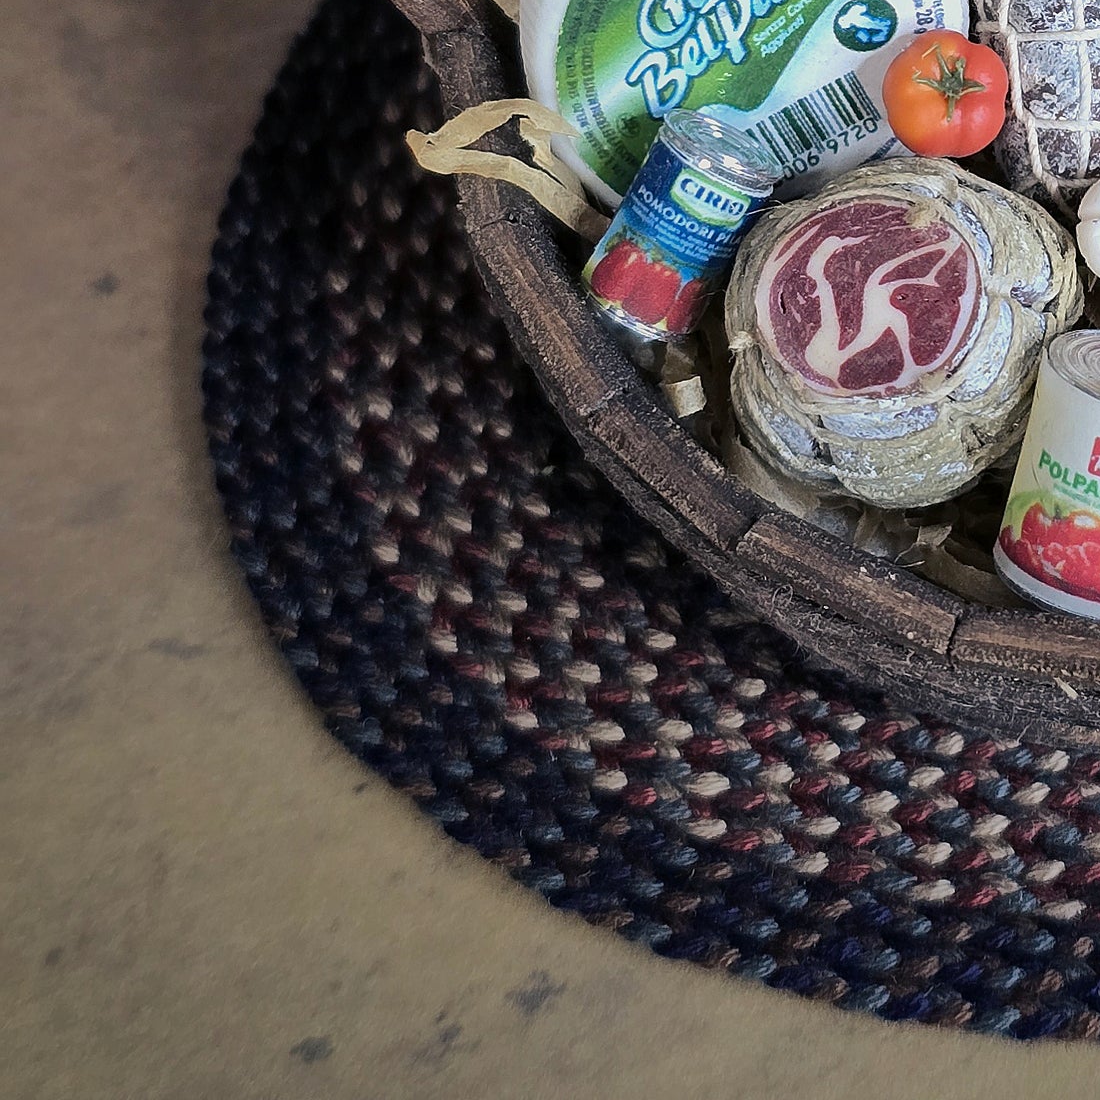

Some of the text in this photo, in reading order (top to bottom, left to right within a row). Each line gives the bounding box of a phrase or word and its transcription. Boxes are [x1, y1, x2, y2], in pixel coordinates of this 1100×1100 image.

[824, 117, 879, 156] 9720
[638, 184, 715, 240] POMODORI
[679, 176, 746, 218] CIRIO
